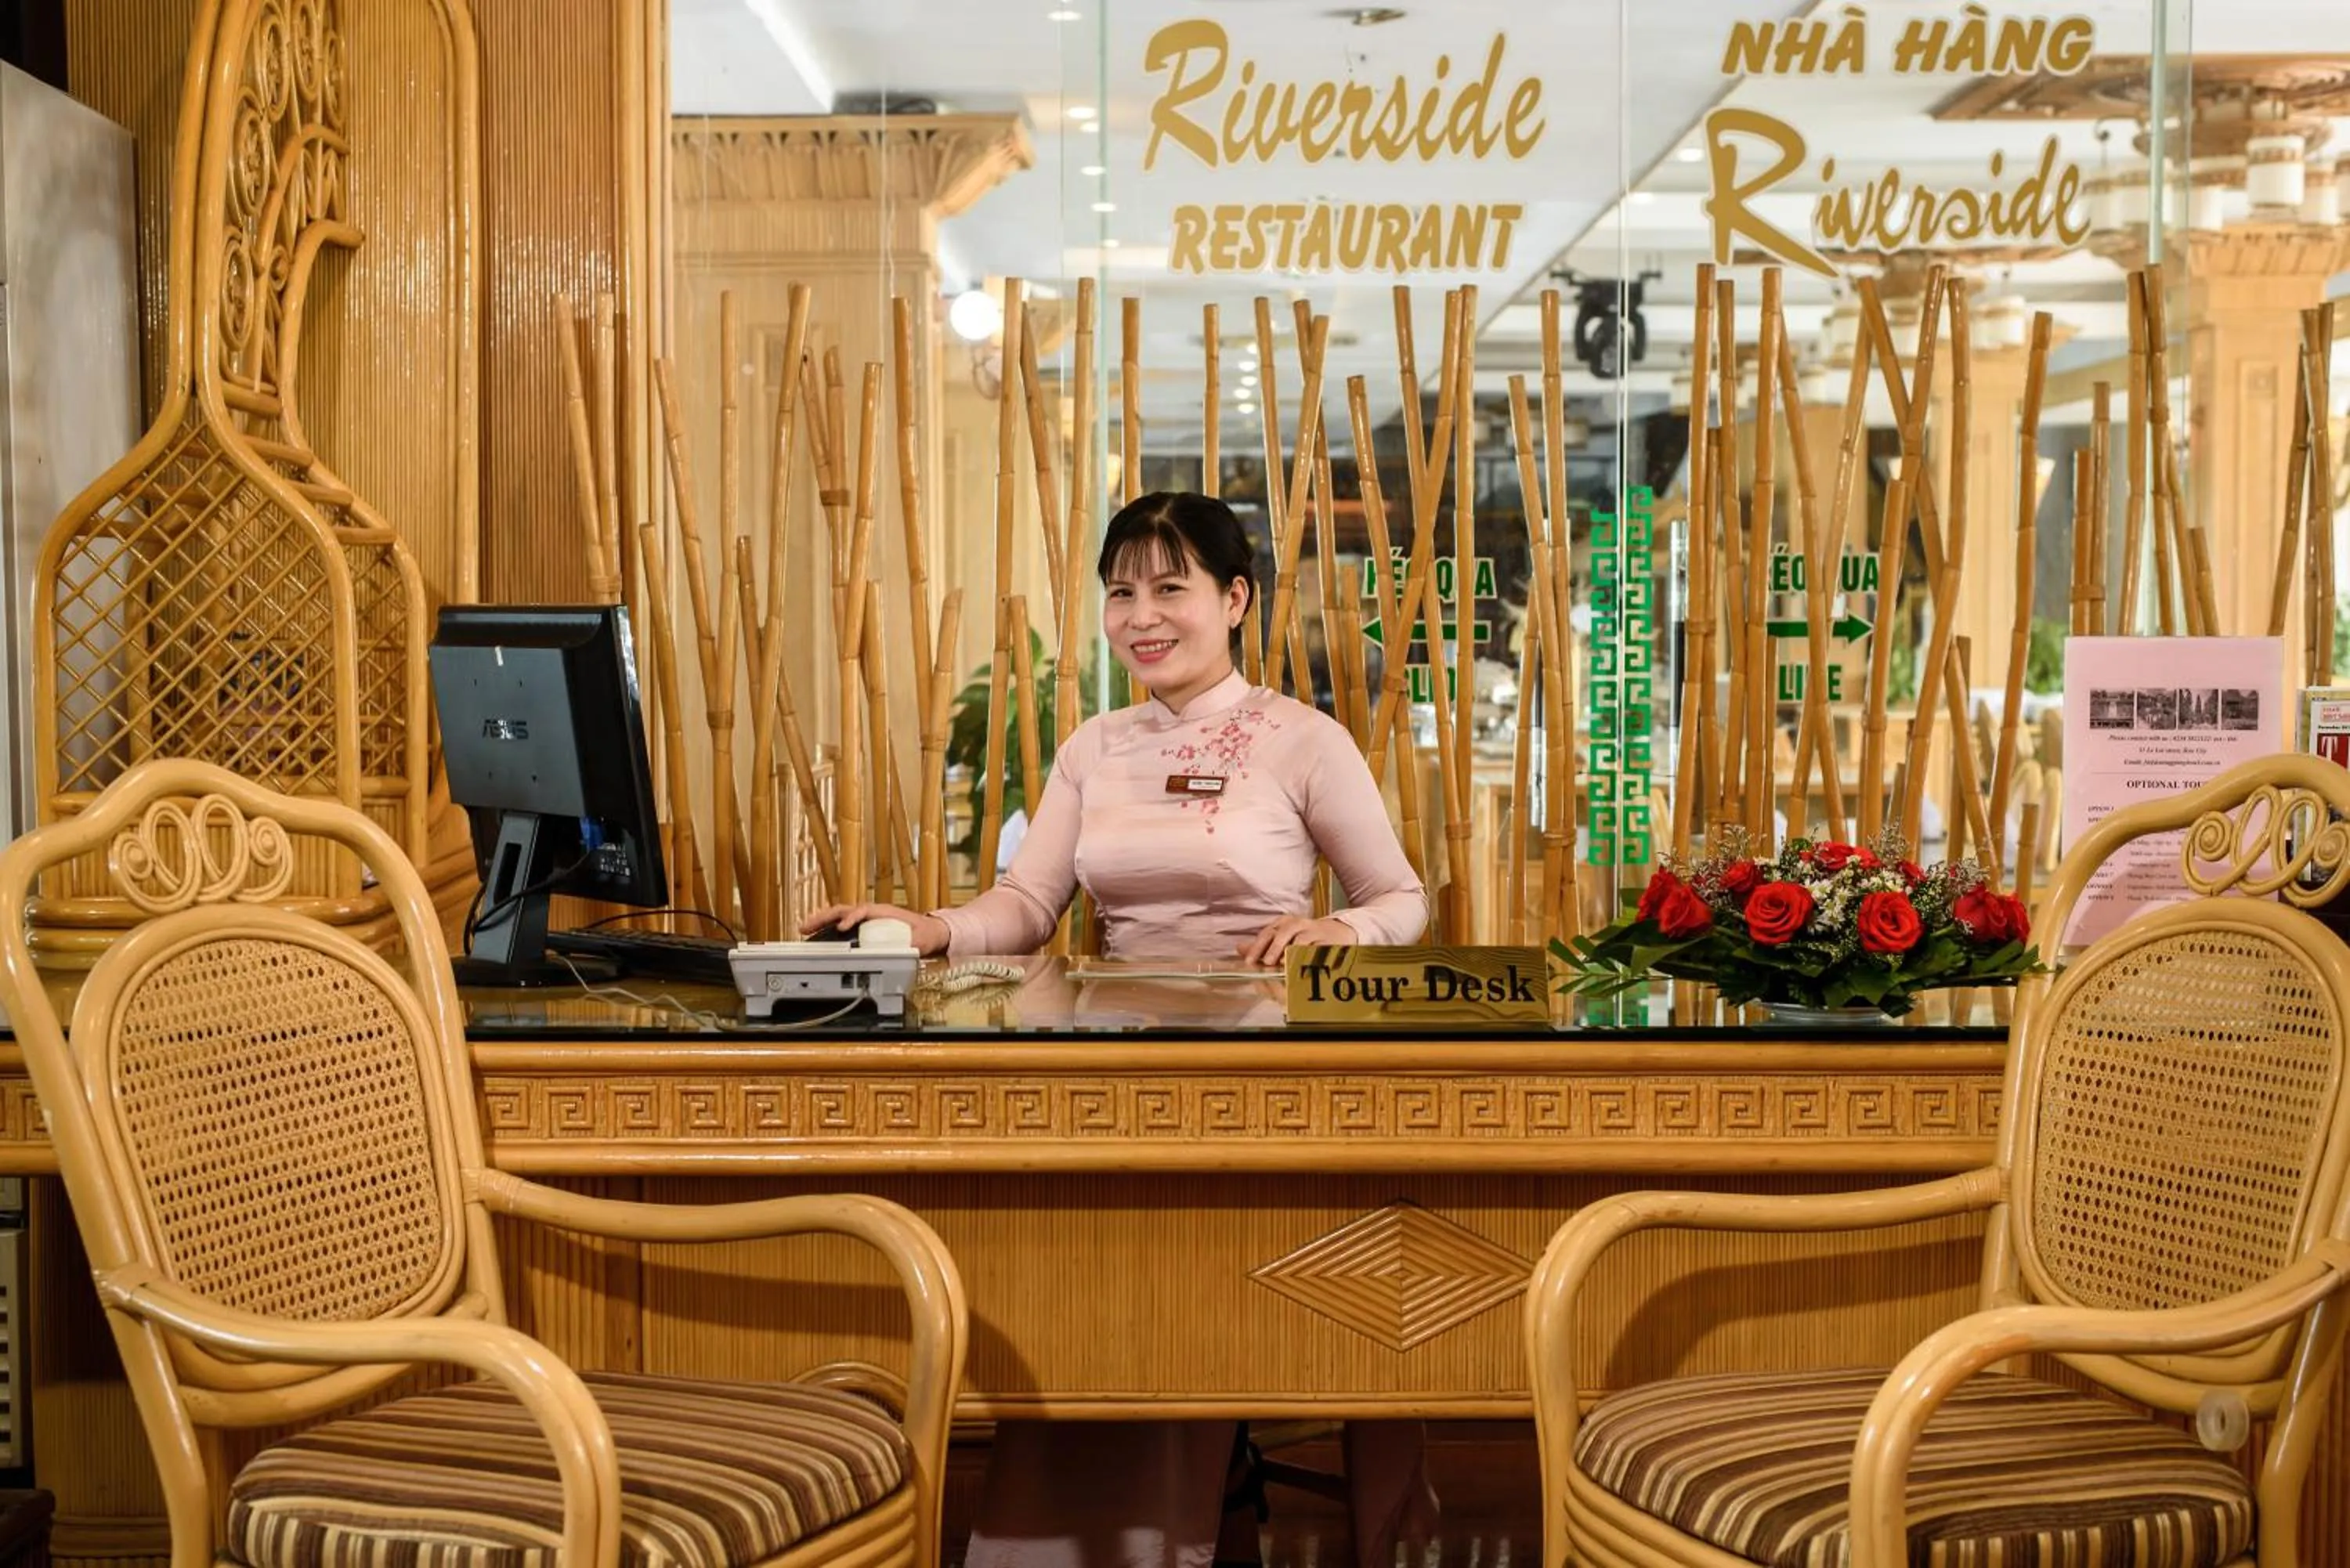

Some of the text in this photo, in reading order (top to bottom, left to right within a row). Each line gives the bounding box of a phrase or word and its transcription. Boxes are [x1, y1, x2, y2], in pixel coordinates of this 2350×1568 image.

[1721, 2, 2095, 76] NHÀ HÀNG
[1143, 18, 1546, 172] Riverside
[1704, 107, 2092, 278] Riverside
[1171, 204, 1524, 274] RESTAURANT
[1436, 559, 1495, 602] QA
[1841, 555, 1878, 592] UA
[482, 718, 530, 741] ASUS
[2127, 779, 2180, 789] OPTIONAL
[1300, 963, 1536, 1003] Tour Desk
